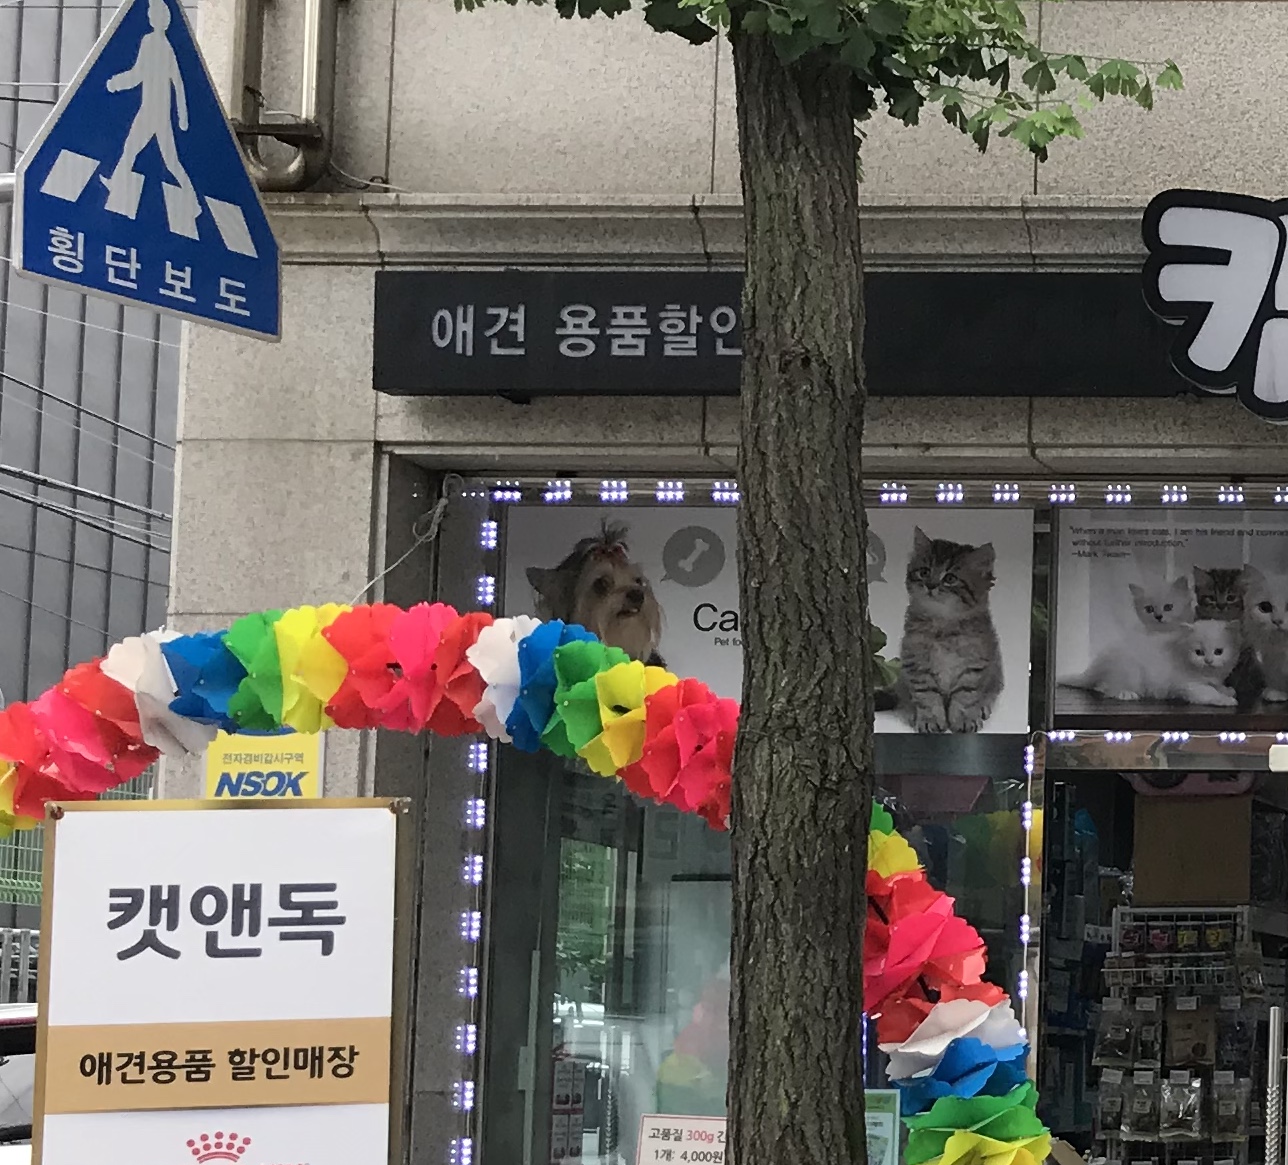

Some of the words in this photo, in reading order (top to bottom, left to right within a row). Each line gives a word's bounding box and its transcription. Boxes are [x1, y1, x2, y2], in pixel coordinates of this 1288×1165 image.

[48, 226, 252, 318] 횡단보도
[431, 304, 527, 358] 애견
[694, 603, 739, 631] Ca
[214, 771, 310, 797] NSOK
[107, 882, 346, 961] 캣앤독
[80, 1049, 216, 1086] 애견용품
[228, 1045, 360, 1081] 할인매장
[648, 1128, 683, 1142] 고품질
[687, 1130, 714, 1143] 300g
[680, 1151, 723, 1164] 4,000원
